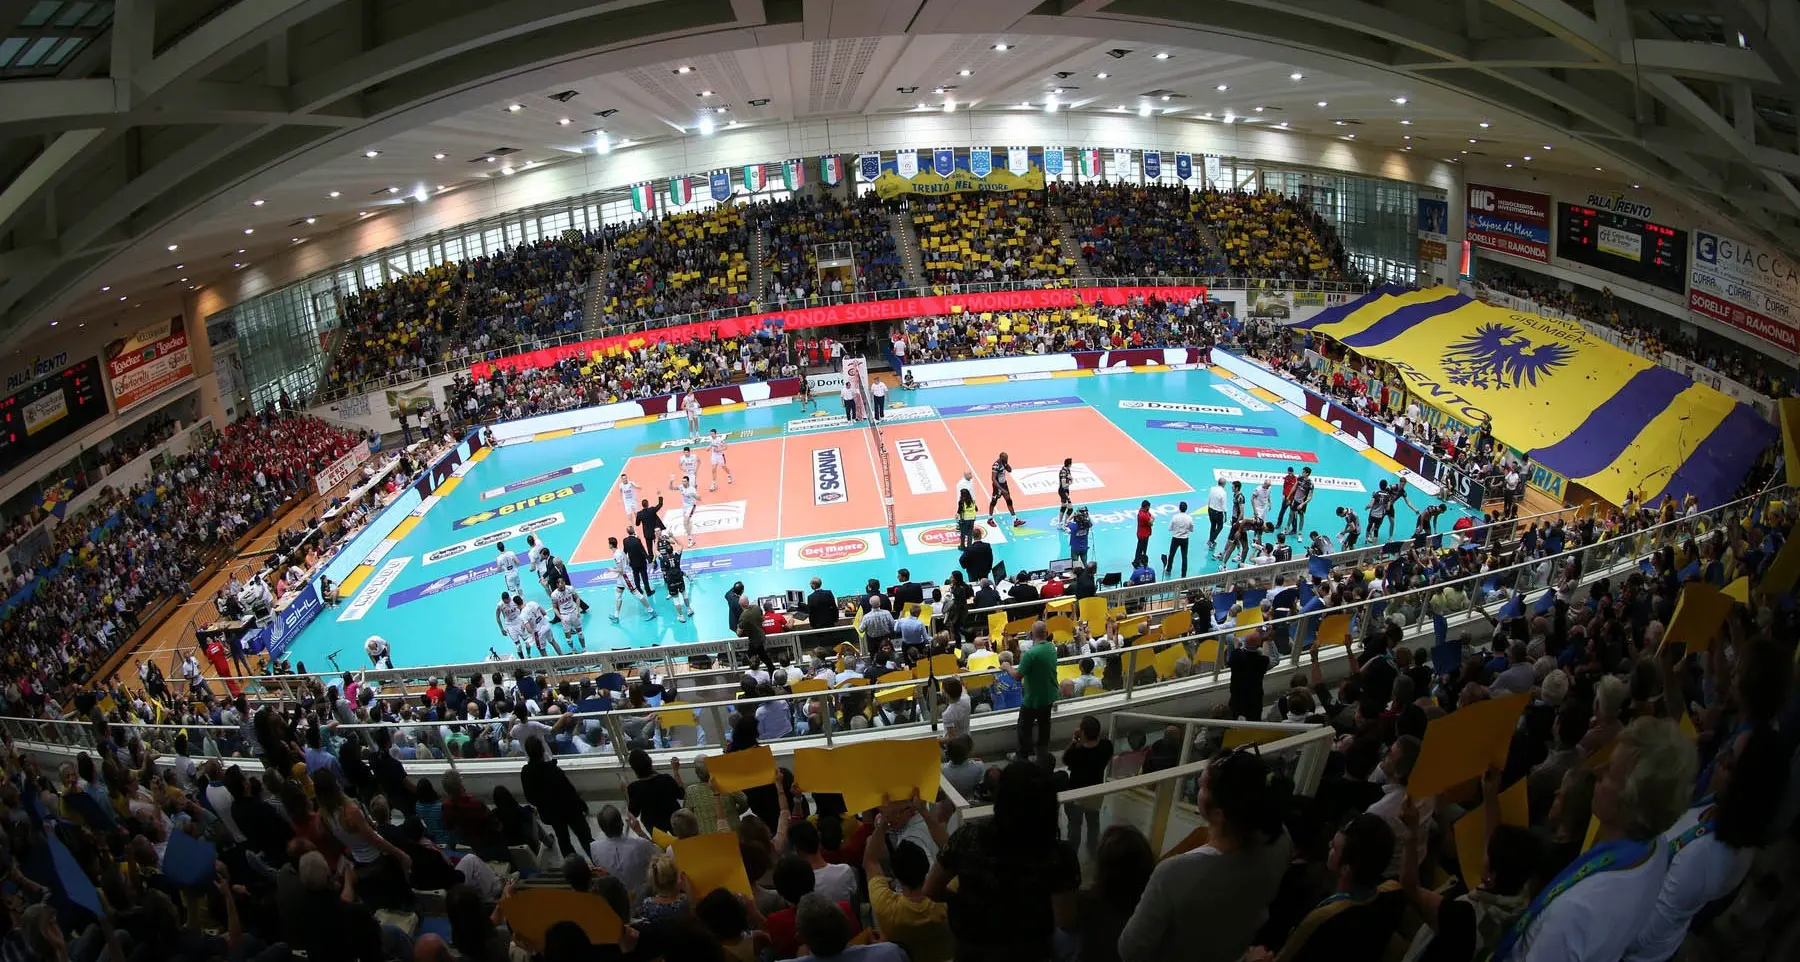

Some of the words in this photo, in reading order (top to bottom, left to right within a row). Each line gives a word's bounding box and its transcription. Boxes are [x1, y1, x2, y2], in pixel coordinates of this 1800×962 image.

[912, 183, 950, 193] TRENTO
[955, 181, 973, 190] NEL
[1586, 194, 1611, 210] PALA
[1612, 191, 1652, 218] TRENTO
[1467, 231, 1496, 247] SORELLE
[1508, 241, 1547, 259] RAMONDA
[744, 309, 837, 334] RAONDA
[849, 301, 917, 320] SORELLE
[944, 293, 1033, 311] RAMONDA
[1691, 294, 1732, 317] SORELLE
[1746, 315, 1796, 345] RAMONDA
[817, 379, 844, 387] Dorig
[1148, 401, 1231, 414] Dorigoni
[898, 439, 929, 462] ITAS
[1194, 445, 1241, 455] trentina
[1257, 448, 1302, 460] trentina
[820, 449, 840, 490] SCANIA
[1022, 475, 1096, 490] linkm
[1314, 478, 1358, 487] Italian
[804, 547, 824, 555] Del
[827, 542, 863, 553] Monte
[618, 652, 660, 663] HERBALIFE
[680, 645, 722, 656] HERBALIFE
[559, 657, 600, 668] HERBALIFE
